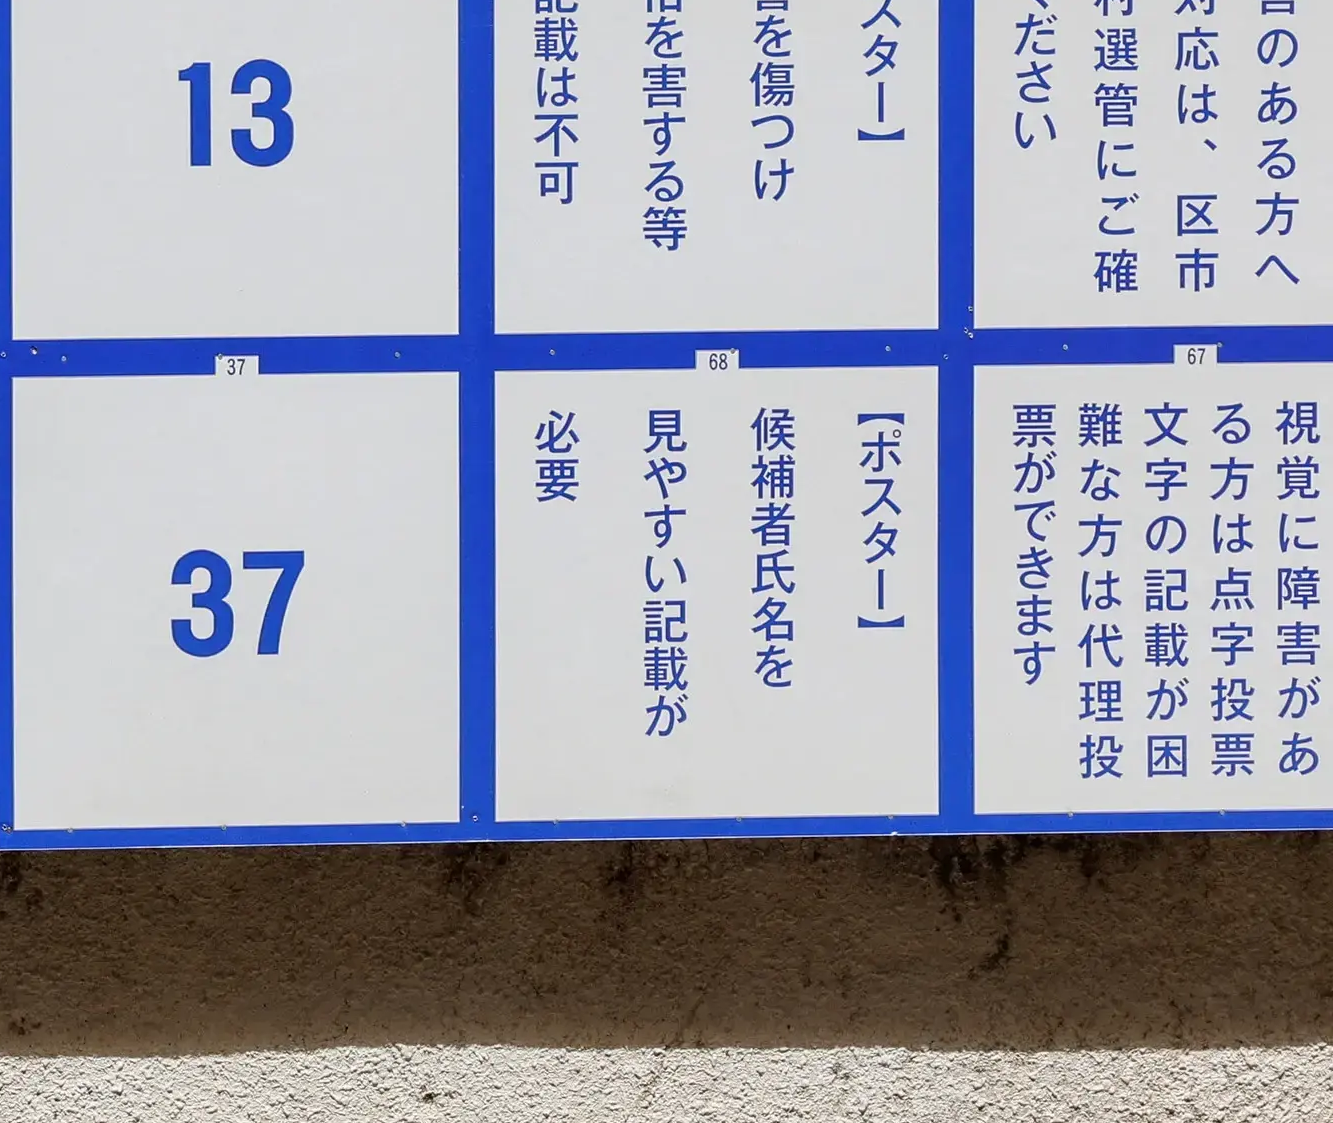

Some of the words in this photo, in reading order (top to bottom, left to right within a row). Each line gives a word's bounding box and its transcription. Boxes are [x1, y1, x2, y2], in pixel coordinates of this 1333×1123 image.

[178, 58, 294, 167] 13
[227, 359, 246, 375] 37
[534, 408, 580, 503] 必要
[709, 353, 728, 370] 68
[1187, 348, 1206, 364] 67
[171, 549, 306, 657] 37
[642, 408, 688, 738] 見やすい記載が
[751, 407, 796, 690] 候補者氏名を
[857, 413, 905, 629] 【ポスター】
[1013, 402, 1057, 687] 票ができます
[1078, 402, 1124, 778] 難な方は代理投
[1144, 402, 1190, 778] 文字の記載が困
[1210, 402, 1255, 777] る方は点字投票
[1277, 401, 1321, 775] 視覚に障害があ
